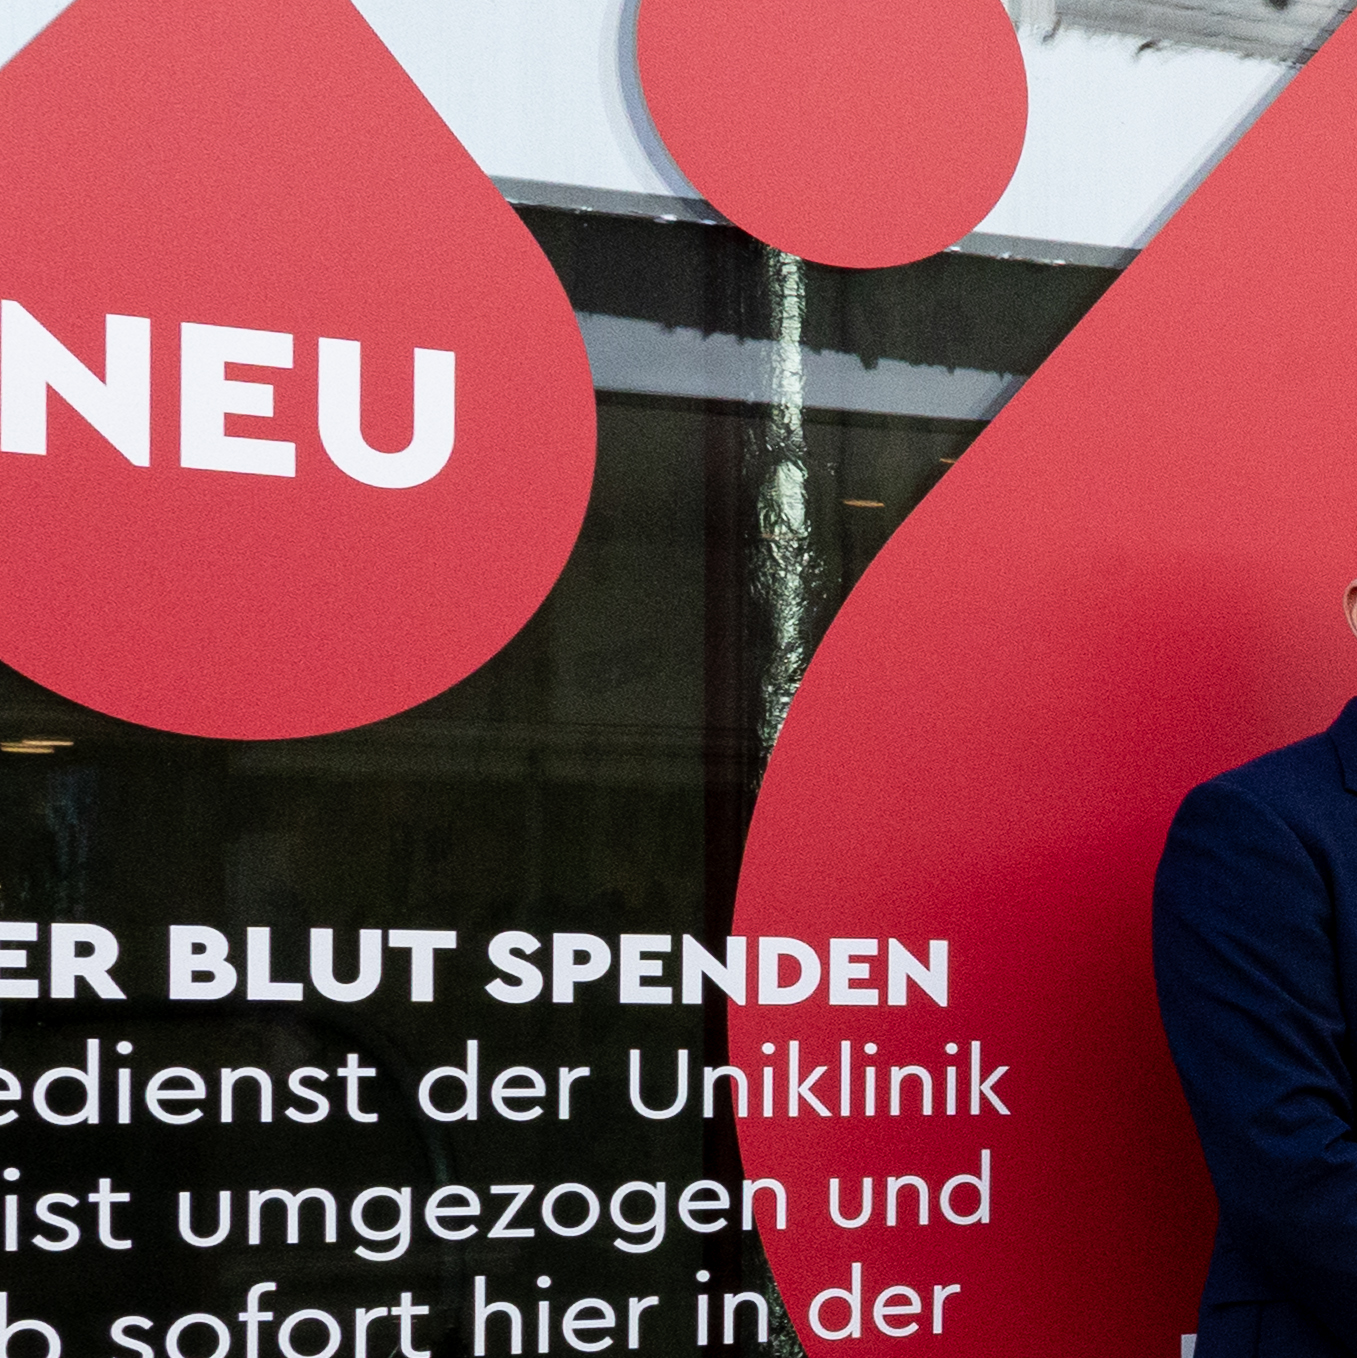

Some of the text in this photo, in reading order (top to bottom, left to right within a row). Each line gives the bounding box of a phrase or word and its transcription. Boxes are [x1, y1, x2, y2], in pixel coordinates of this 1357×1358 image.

[0, 300, 455, 488] NEU
[170, 926, 456, 1001] BLUT
[486, 931, 947, 1006] SPENDEN
[418, 1040, 590, 1121] der
[630, 1040, 1010, 1119] Uniklinik
[3, 1149, 990, 1261] ist umgezogen und
[474, 1276, 659, 1356] hier
[696, 1270, 768, 1345] in
[809, 1262, 960, 1340] der
